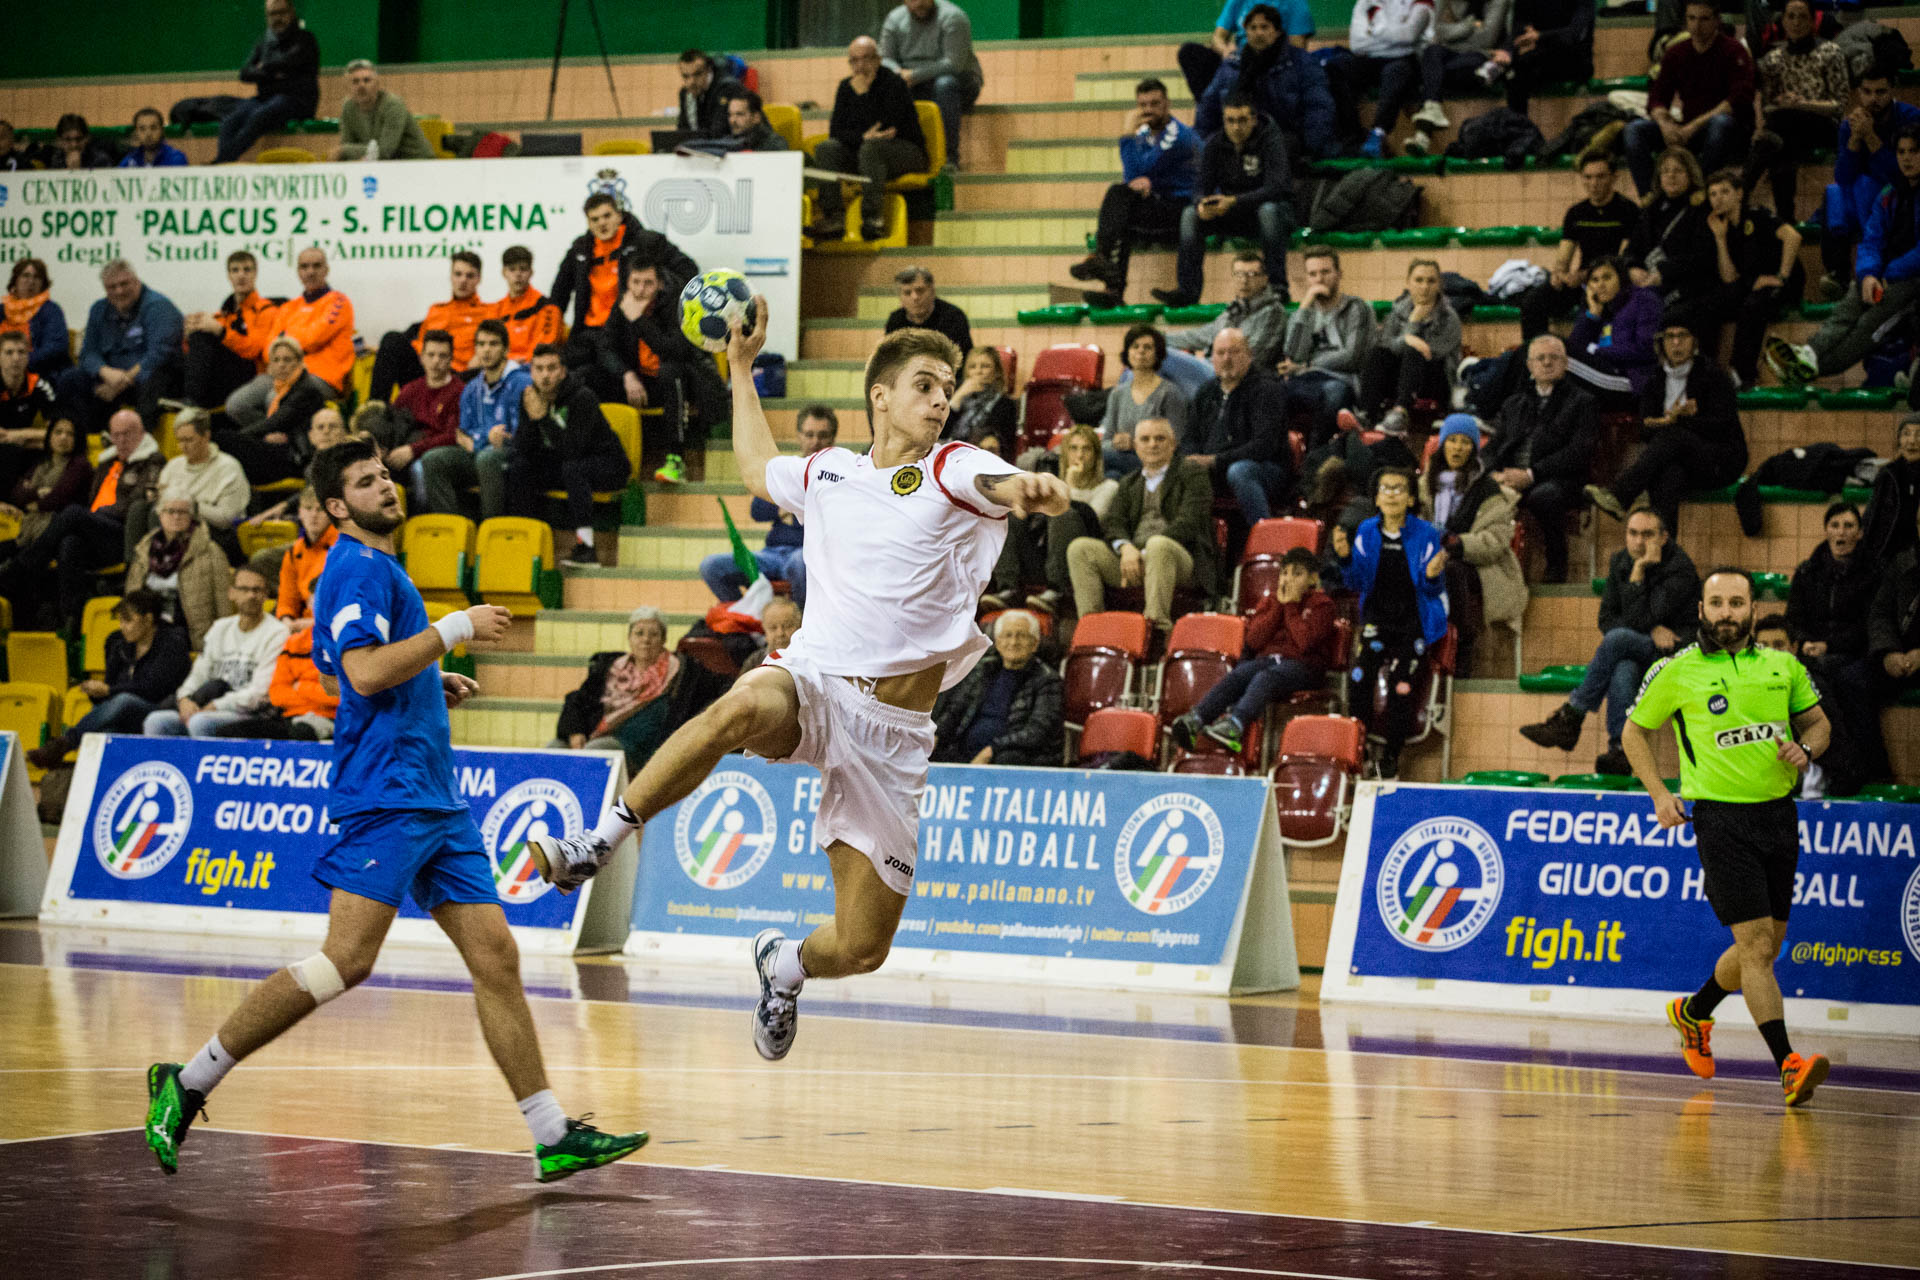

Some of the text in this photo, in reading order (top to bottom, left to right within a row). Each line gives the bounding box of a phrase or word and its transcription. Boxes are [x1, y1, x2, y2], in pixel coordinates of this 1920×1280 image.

[22, 178, 98, 206] CENTRO
[251, 173, 348, 201] SPORTIVO
[41, 209, 118, 238] SPORT
[290, 206, 308, 235] 2
[343, 205, 368, 234] S.
[57, 243, 121, 265] degli
[146, 240, 218, 262] Studi
[817, 470, 845, 483] Jom
[214, 800, 314, 834] GIUOCO
[980, 787, 1107, 828] ITALIANA
[1151, 796, 1202, 811] ITALIANA
[924, 825, 1101, 871] HANDBALL
[184, 847, 277, 896] figh.it
[1383, 824, 1497, 943] FEDERAZIONE ITALIANA GIUOCO HANDBALL
[1538, 862, 1670, 899] GIUOCO
[916, 879, 1096, 906] www.pallamano.tv
[1505, 916, 1903, 969] figh.it @fighpress
